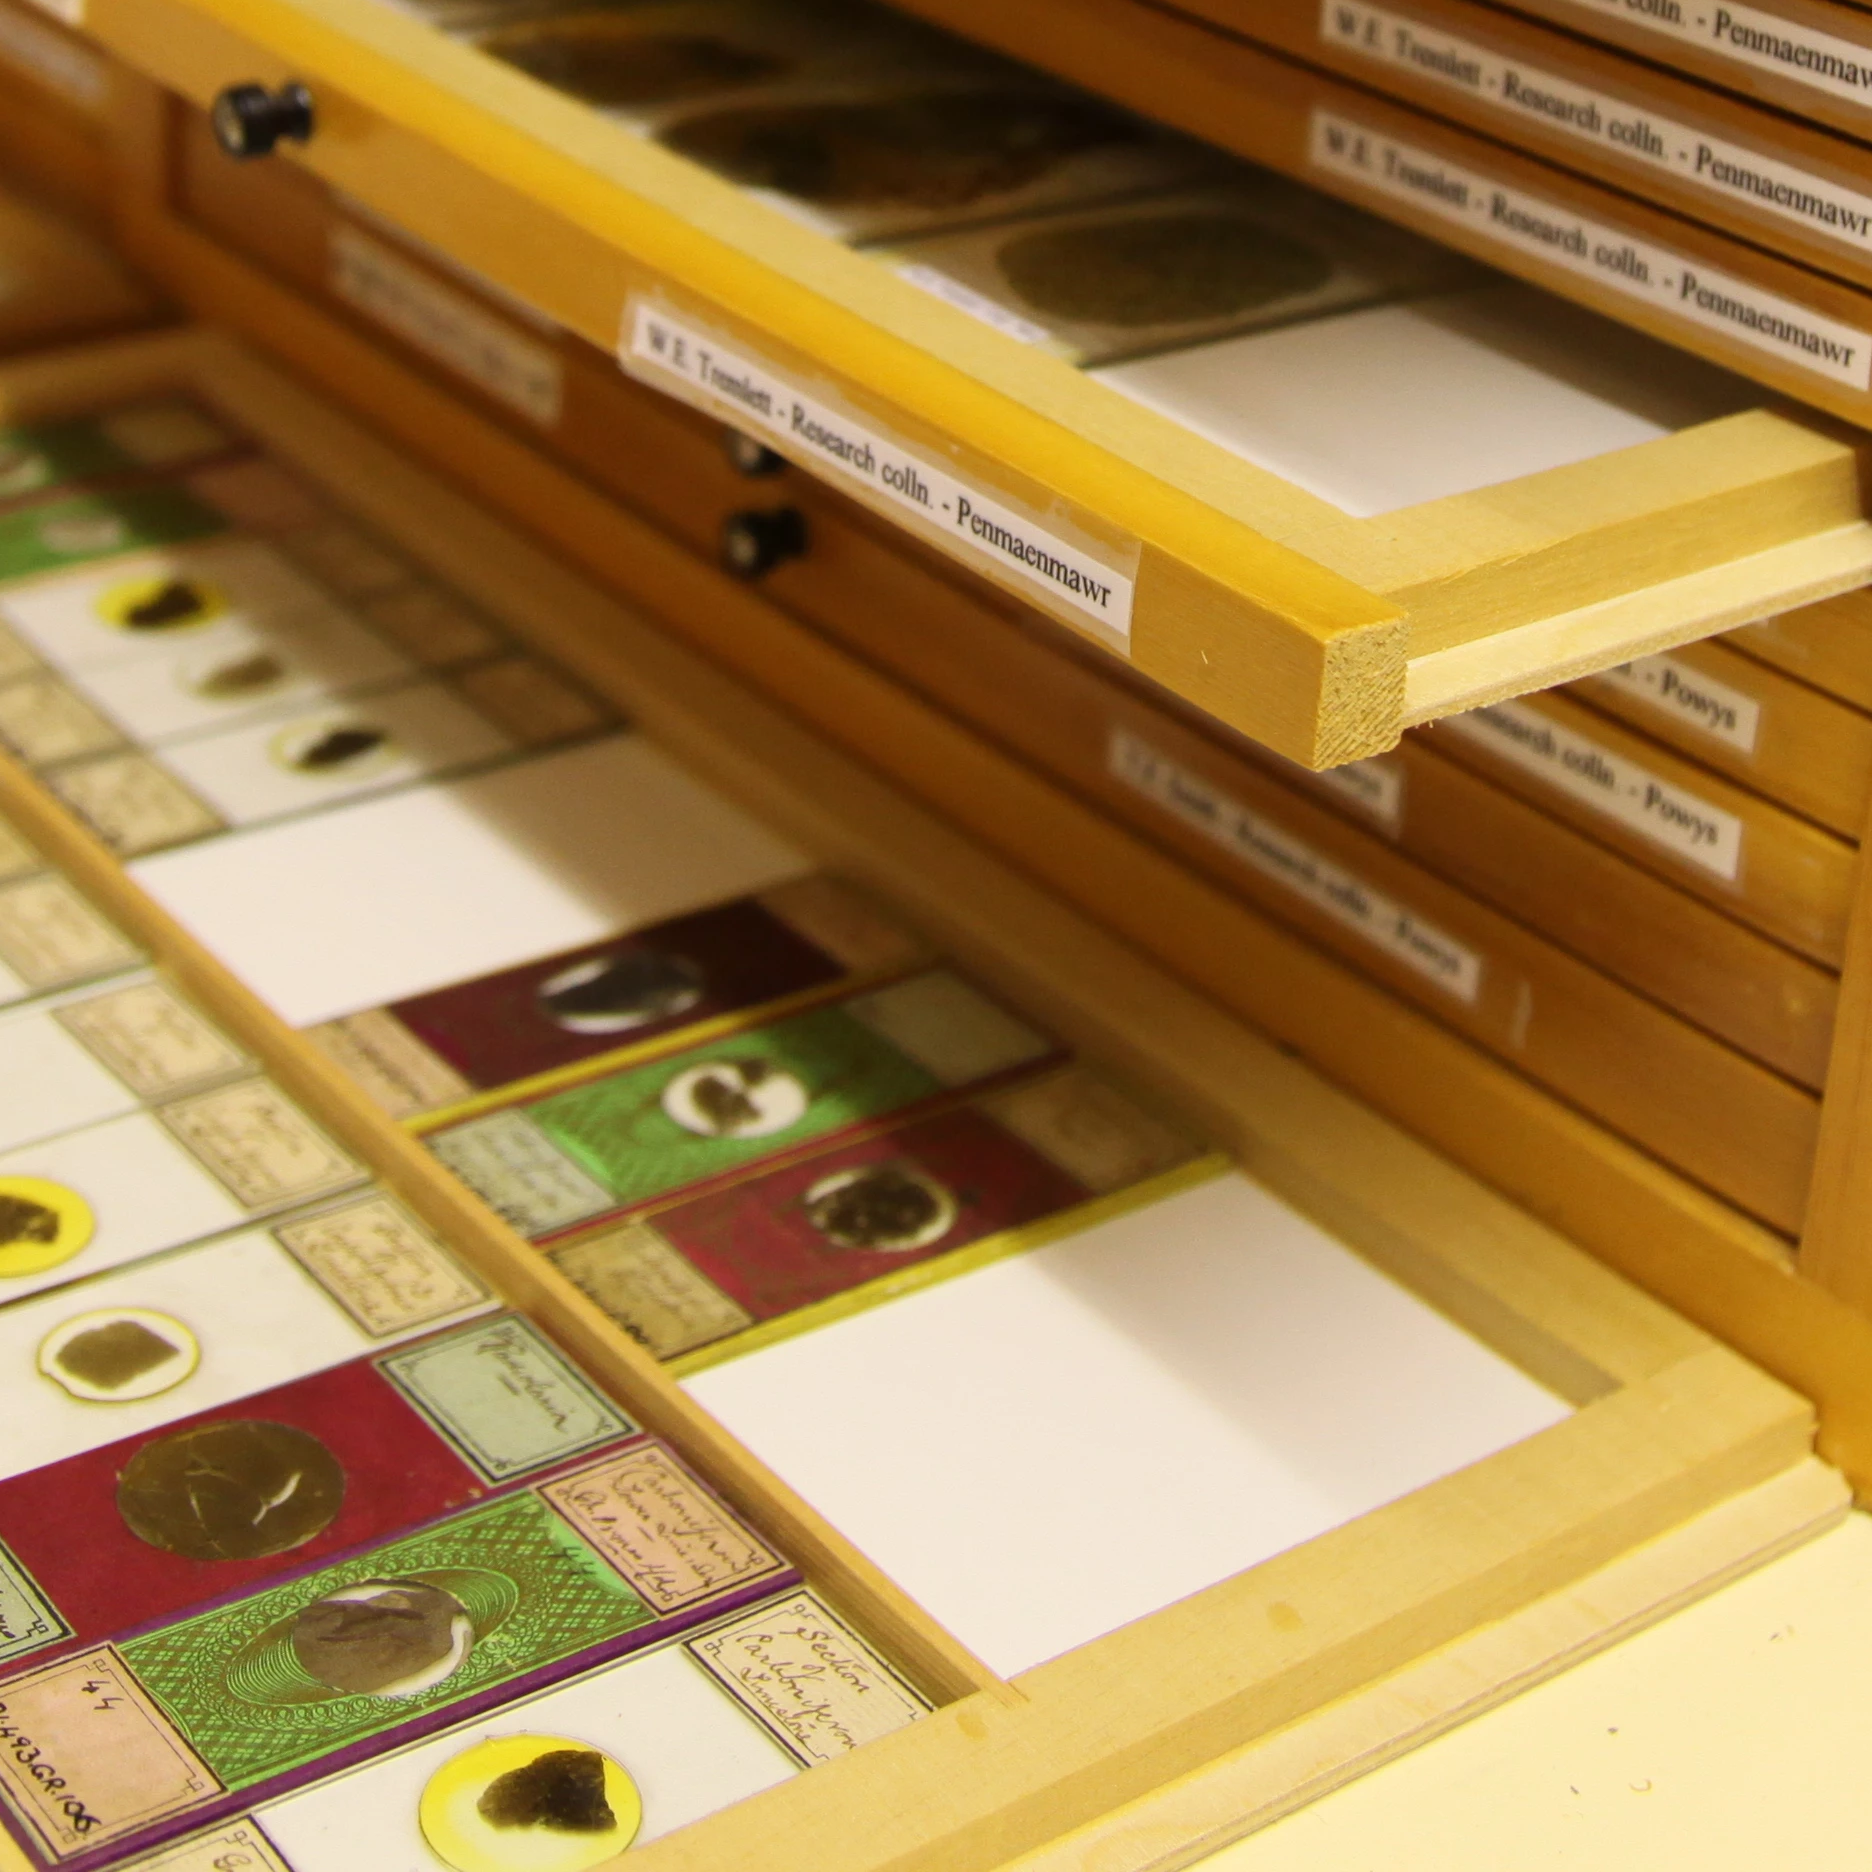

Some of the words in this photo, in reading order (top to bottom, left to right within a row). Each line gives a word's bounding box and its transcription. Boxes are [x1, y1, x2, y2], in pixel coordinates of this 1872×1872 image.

[1503, 71, 1601, 133] Research
[1608, 109, 1670, 159] colln.
[1491, 191, 1588, 256] Research
[1595, 236, 1655, 286] colln.
[1680, 271, 1855, 369] Penmaenmawr
[698, 351, 772, 417] Tremlett
[791, 404, 875, 473] Research
[882, 460, 933, 508] colln.
[957, 496, 1111, 608] Penmaenmawr
[1661, 668, 1736, 730] Powys
[1644, 783, 1718, 845] Powys
[793, 1627, 870, 1695] Section
